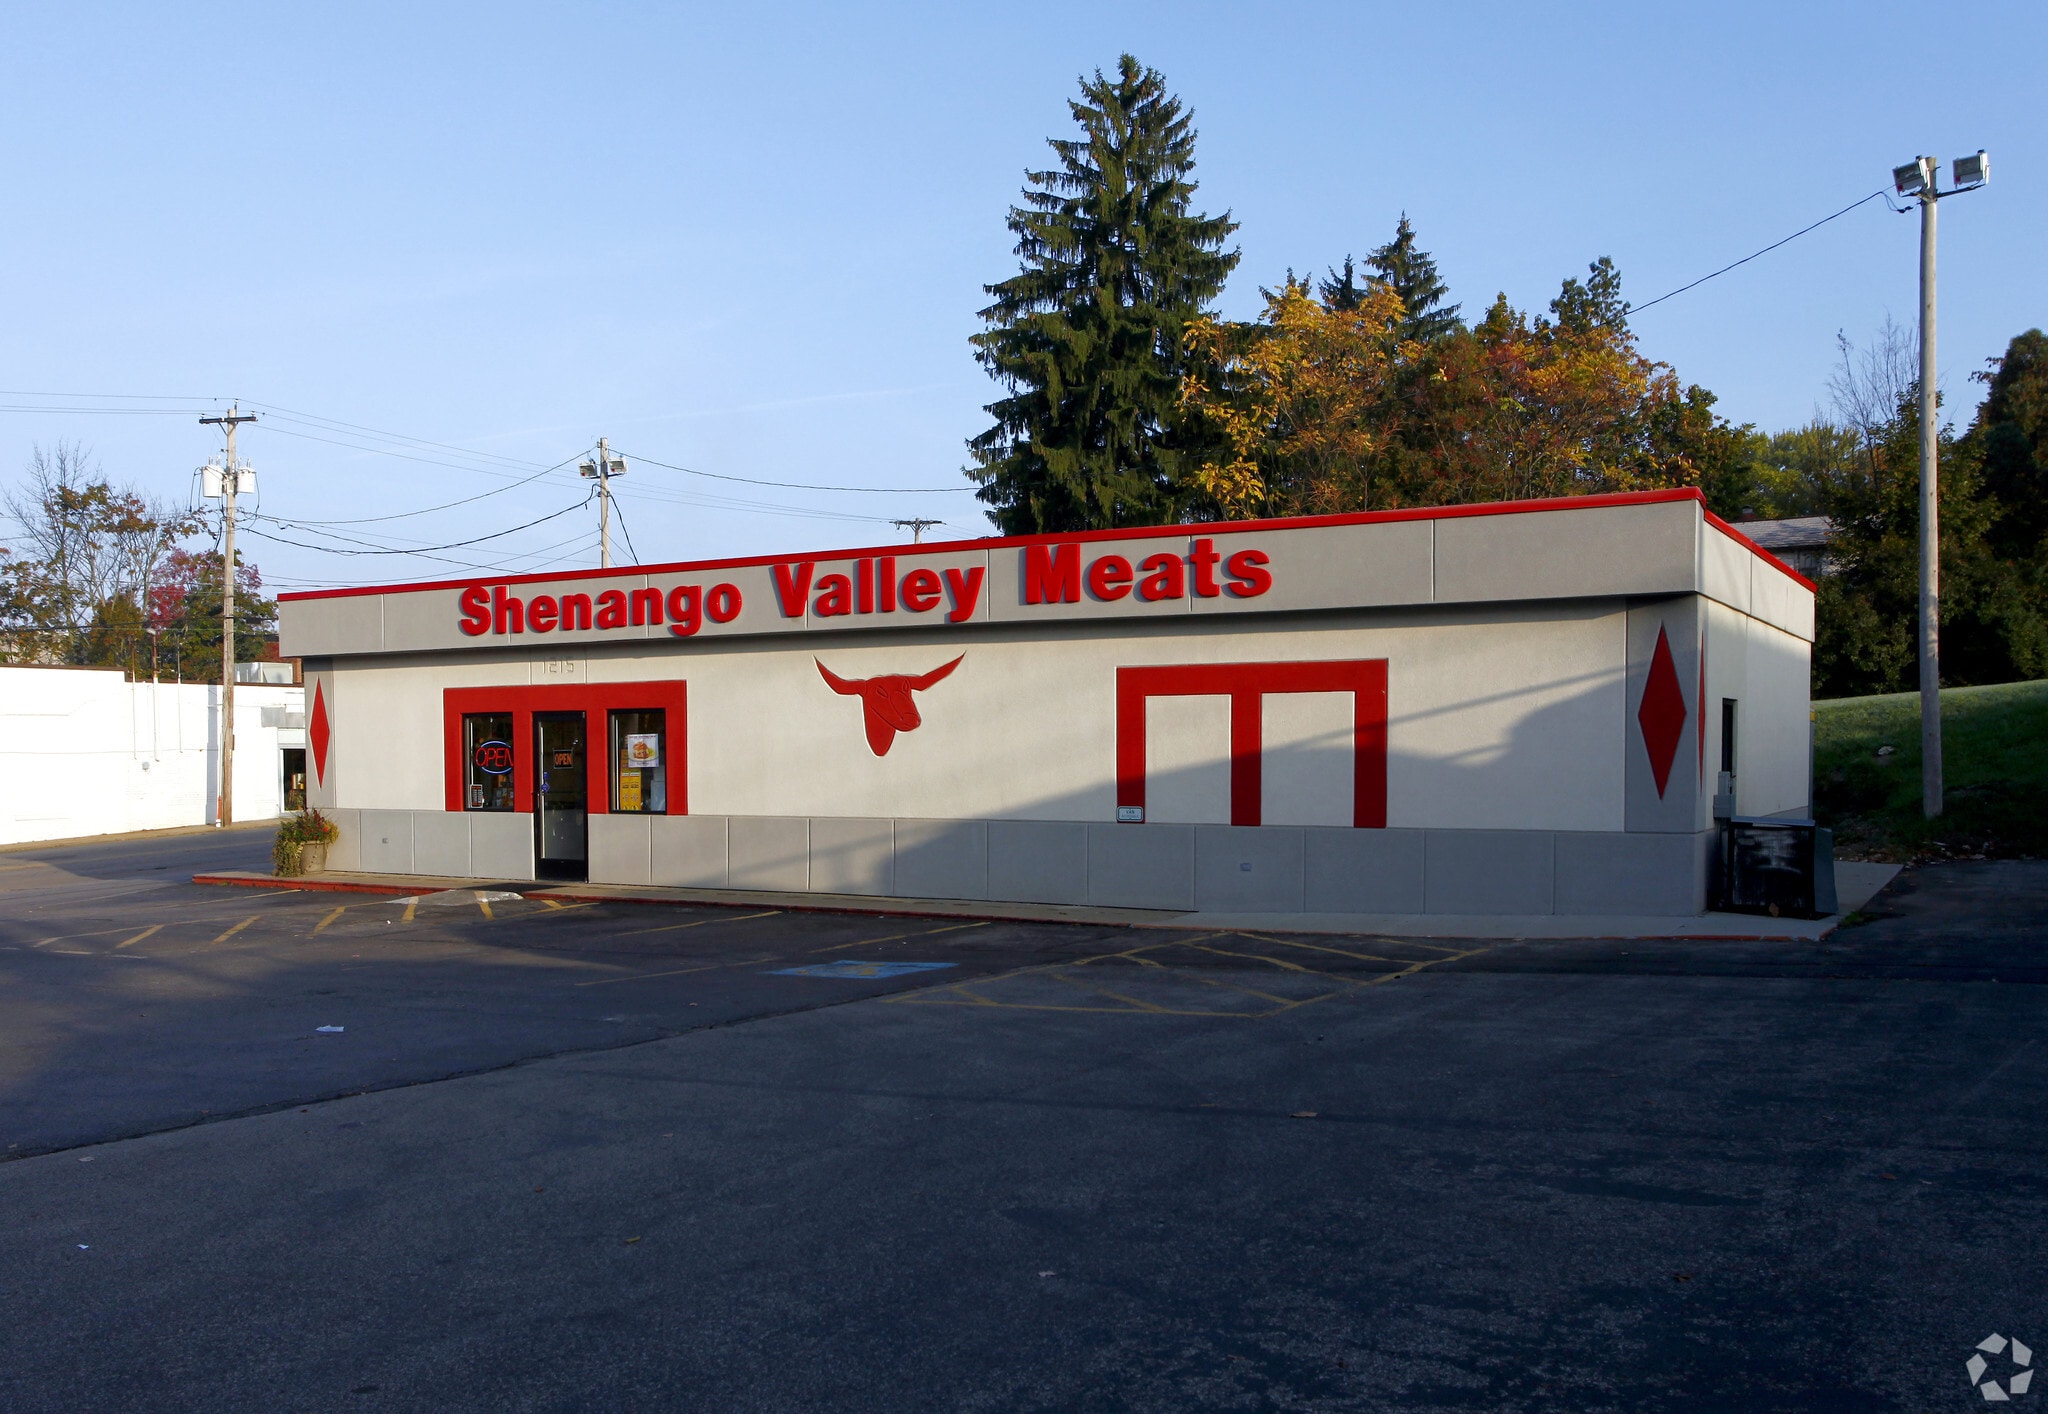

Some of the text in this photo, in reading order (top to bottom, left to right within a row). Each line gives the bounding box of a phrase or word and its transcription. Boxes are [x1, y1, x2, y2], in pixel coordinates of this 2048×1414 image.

[460, 538, 1273, 637] Shenango Valley Meats
[543, 657, 574, 673] 1215
[475, 747, 514, 766] OPEN
[554, 753, 572, 765] OPEN
